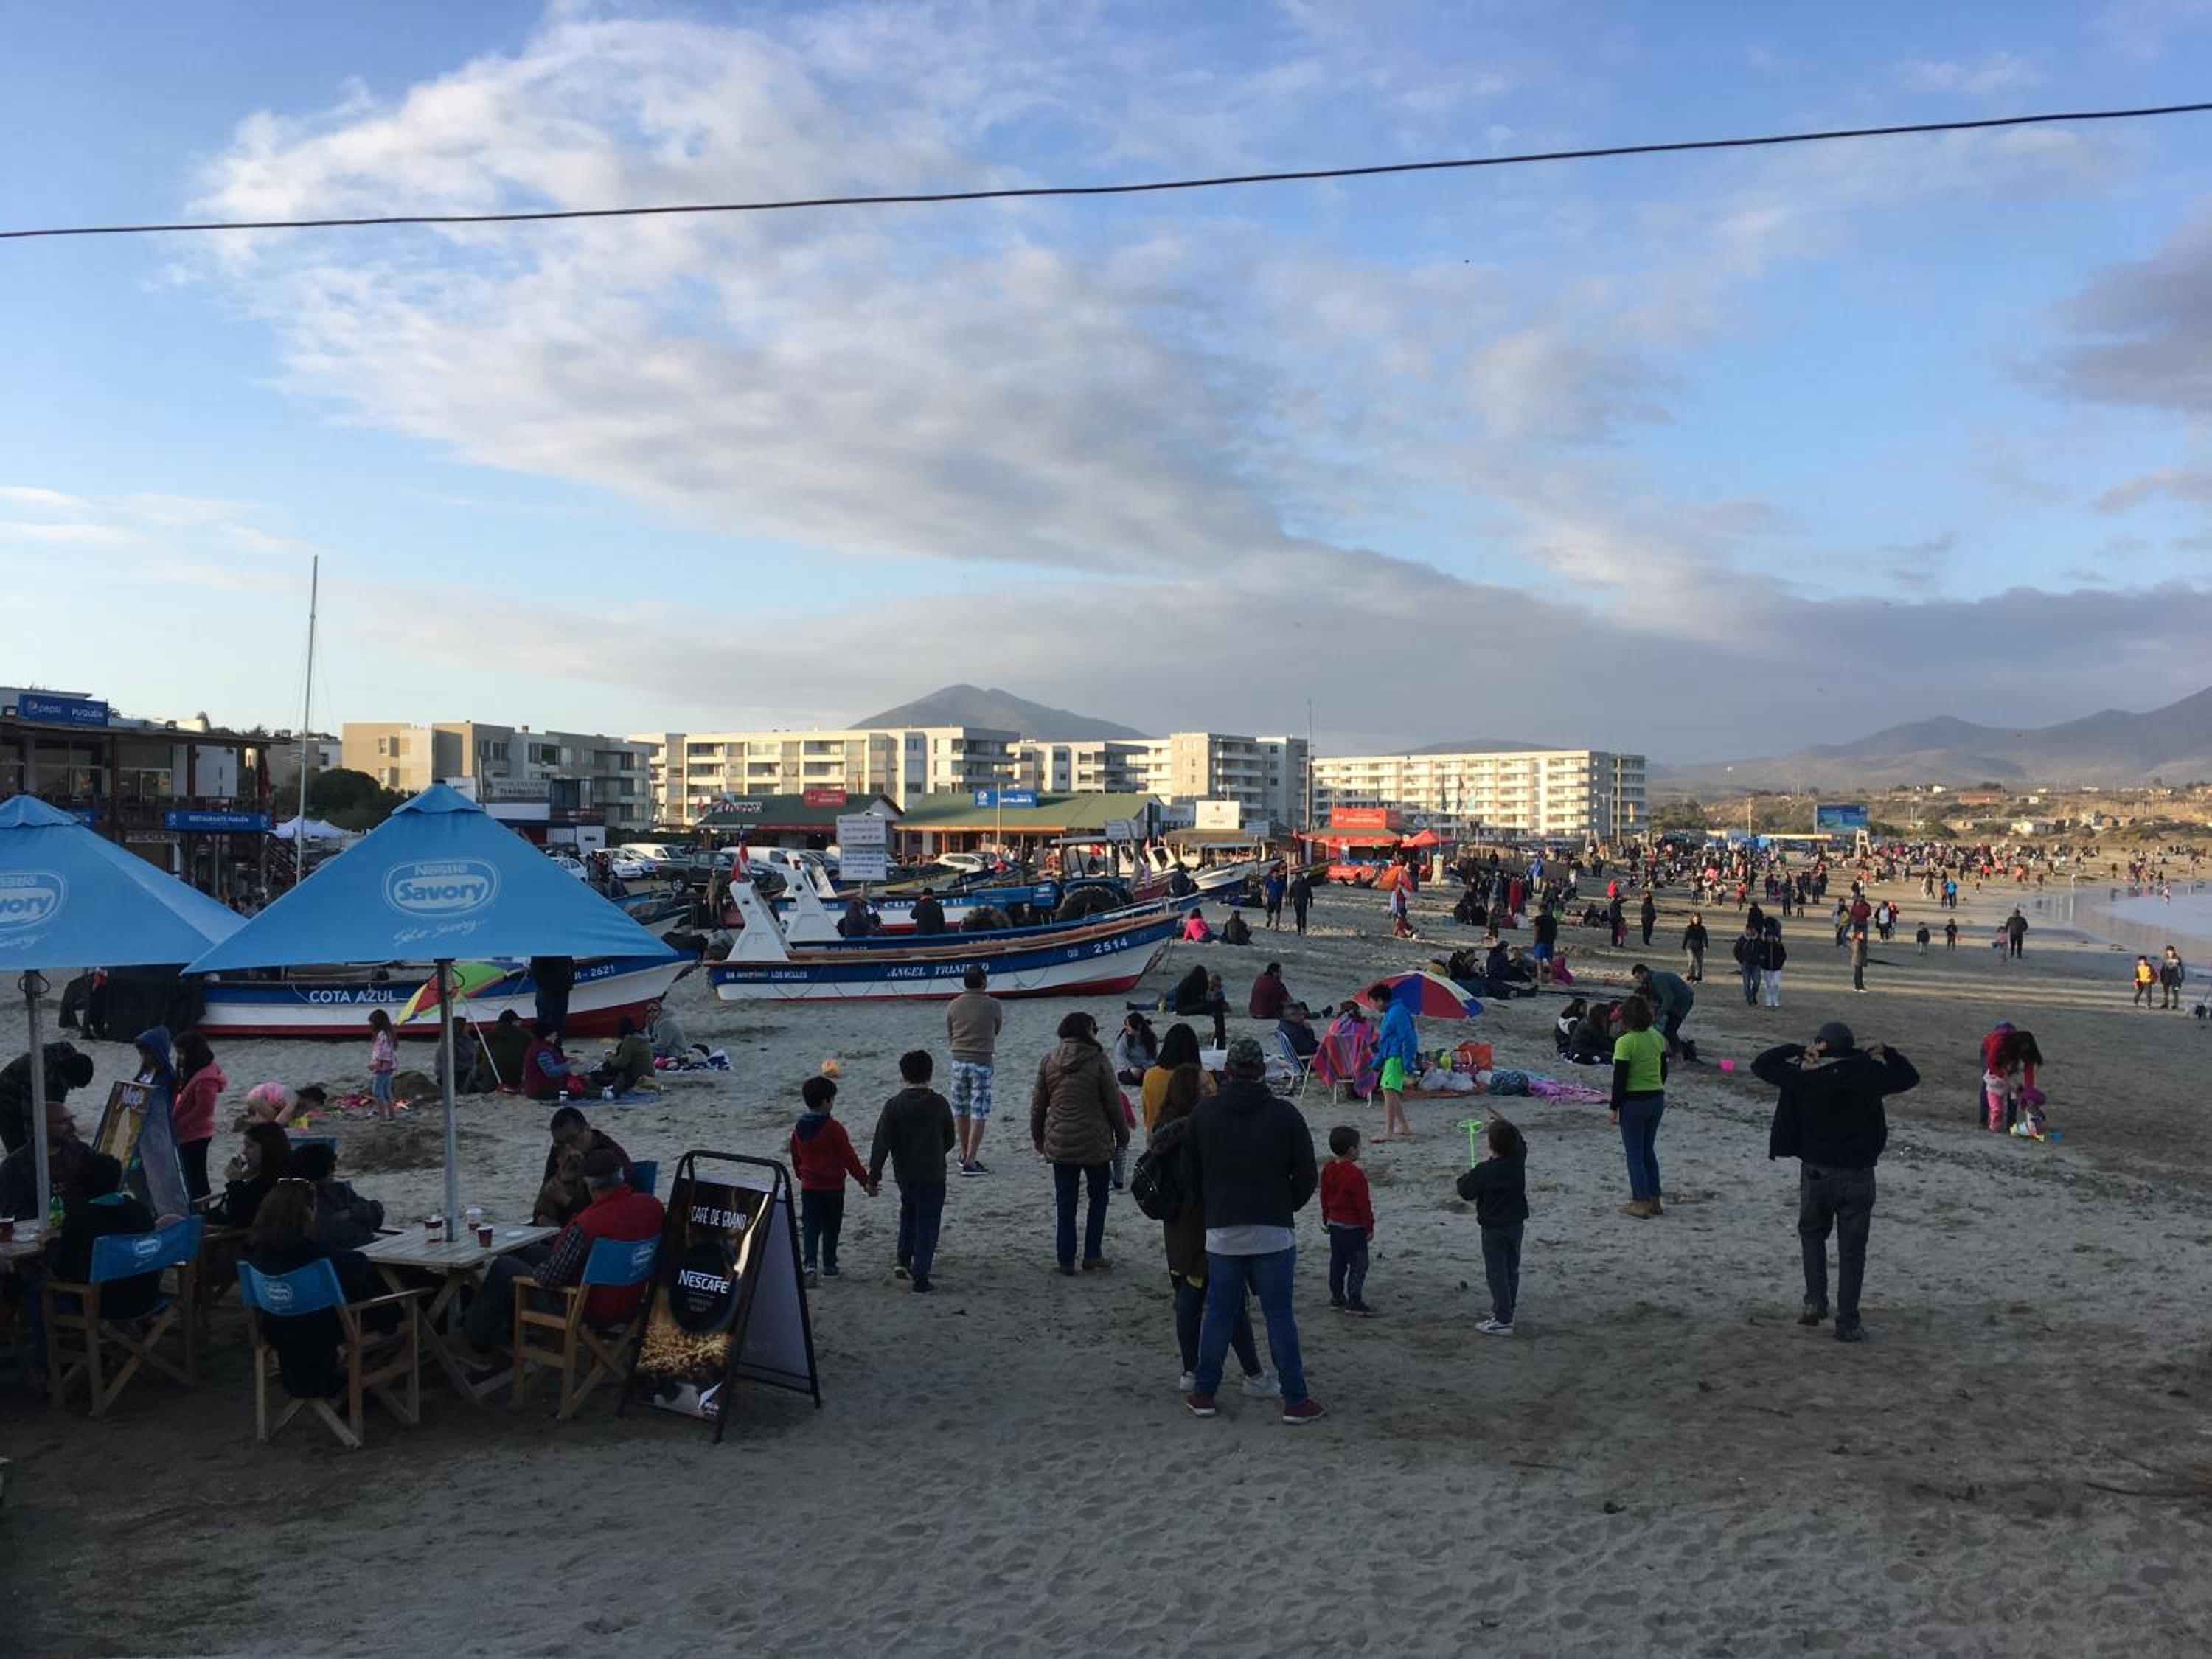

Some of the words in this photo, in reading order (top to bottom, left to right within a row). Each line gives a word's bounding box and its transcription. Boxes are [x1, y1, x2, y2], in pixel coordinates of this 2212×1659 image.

[400, 883, 485, 902] Savory
[1093, 936, 1127, 953] 2514
[590, 964, 615, 978] 2621
[771, 970, 783, 979] LOS
[310, 990, 350, 1003] COTA
[355, 990, 396, 1003] AZUL
[710, 1208, 722, 1227] DE
[722, 1210, 747, 1231] GRANO
